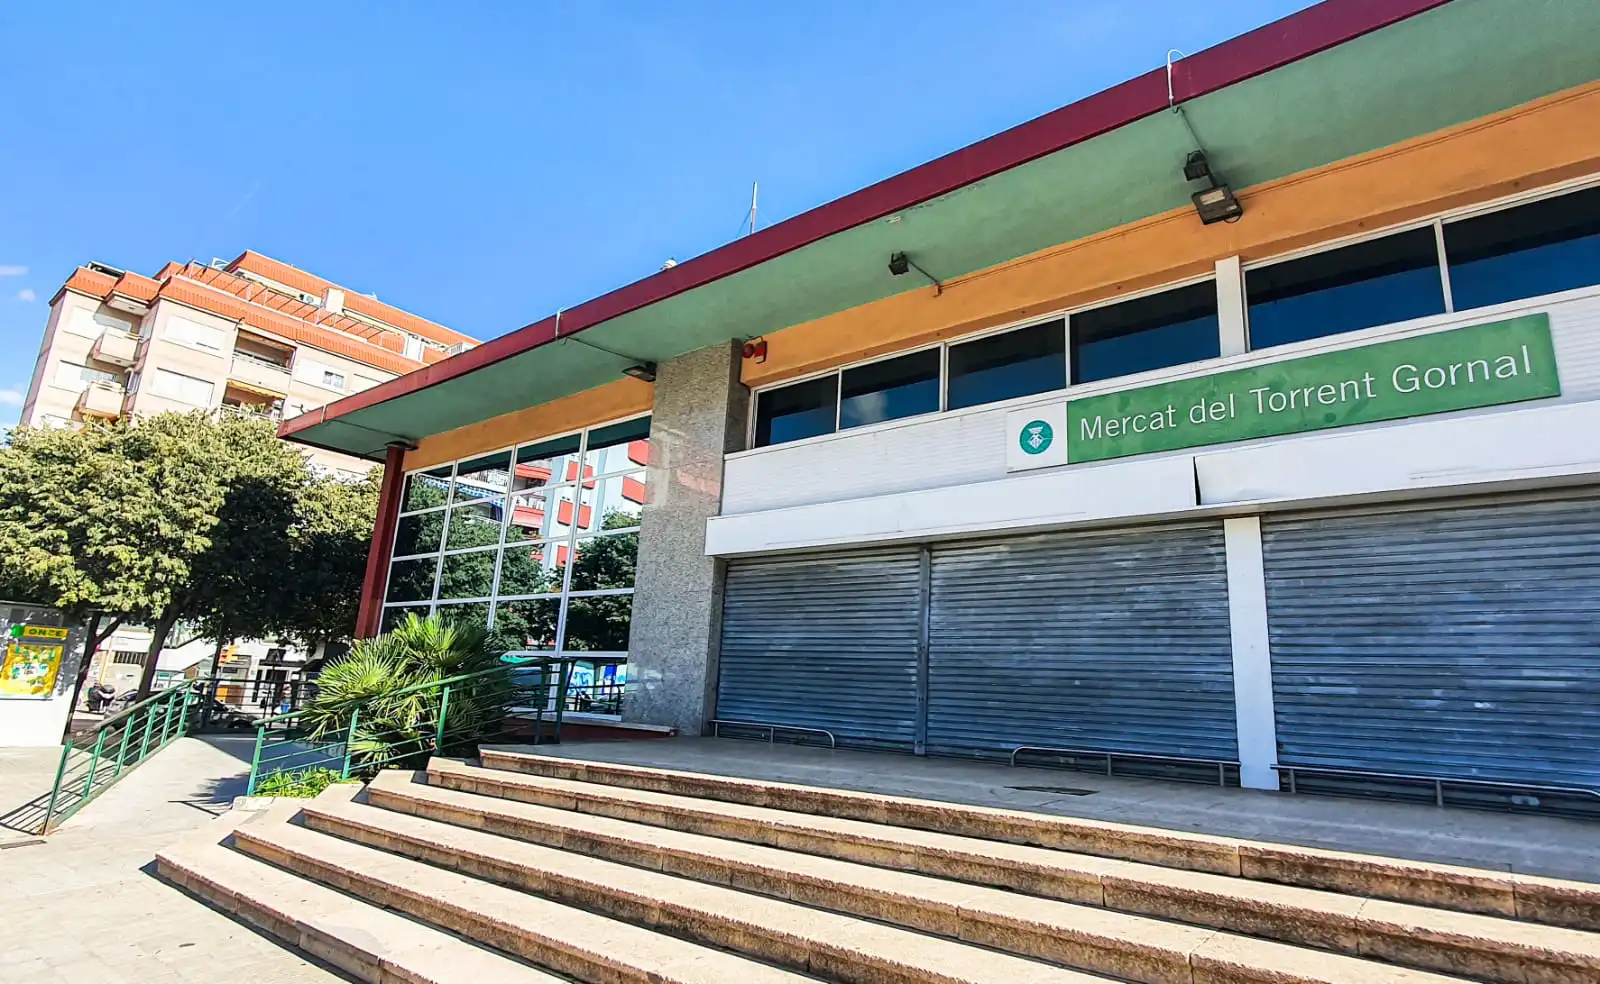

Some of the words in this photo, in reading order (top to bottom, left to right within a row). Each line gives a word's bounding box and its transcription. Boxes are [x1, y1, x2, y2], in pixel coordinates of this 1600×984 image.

[1080, 404, 1177, 441] Mercat
[1189, 393, 1236, 423] del
[1250, 371, 1377, 415] Torrent
[1392, 345, 1533, 394] Gornal
[28, 628, 63, 637] ONCE
